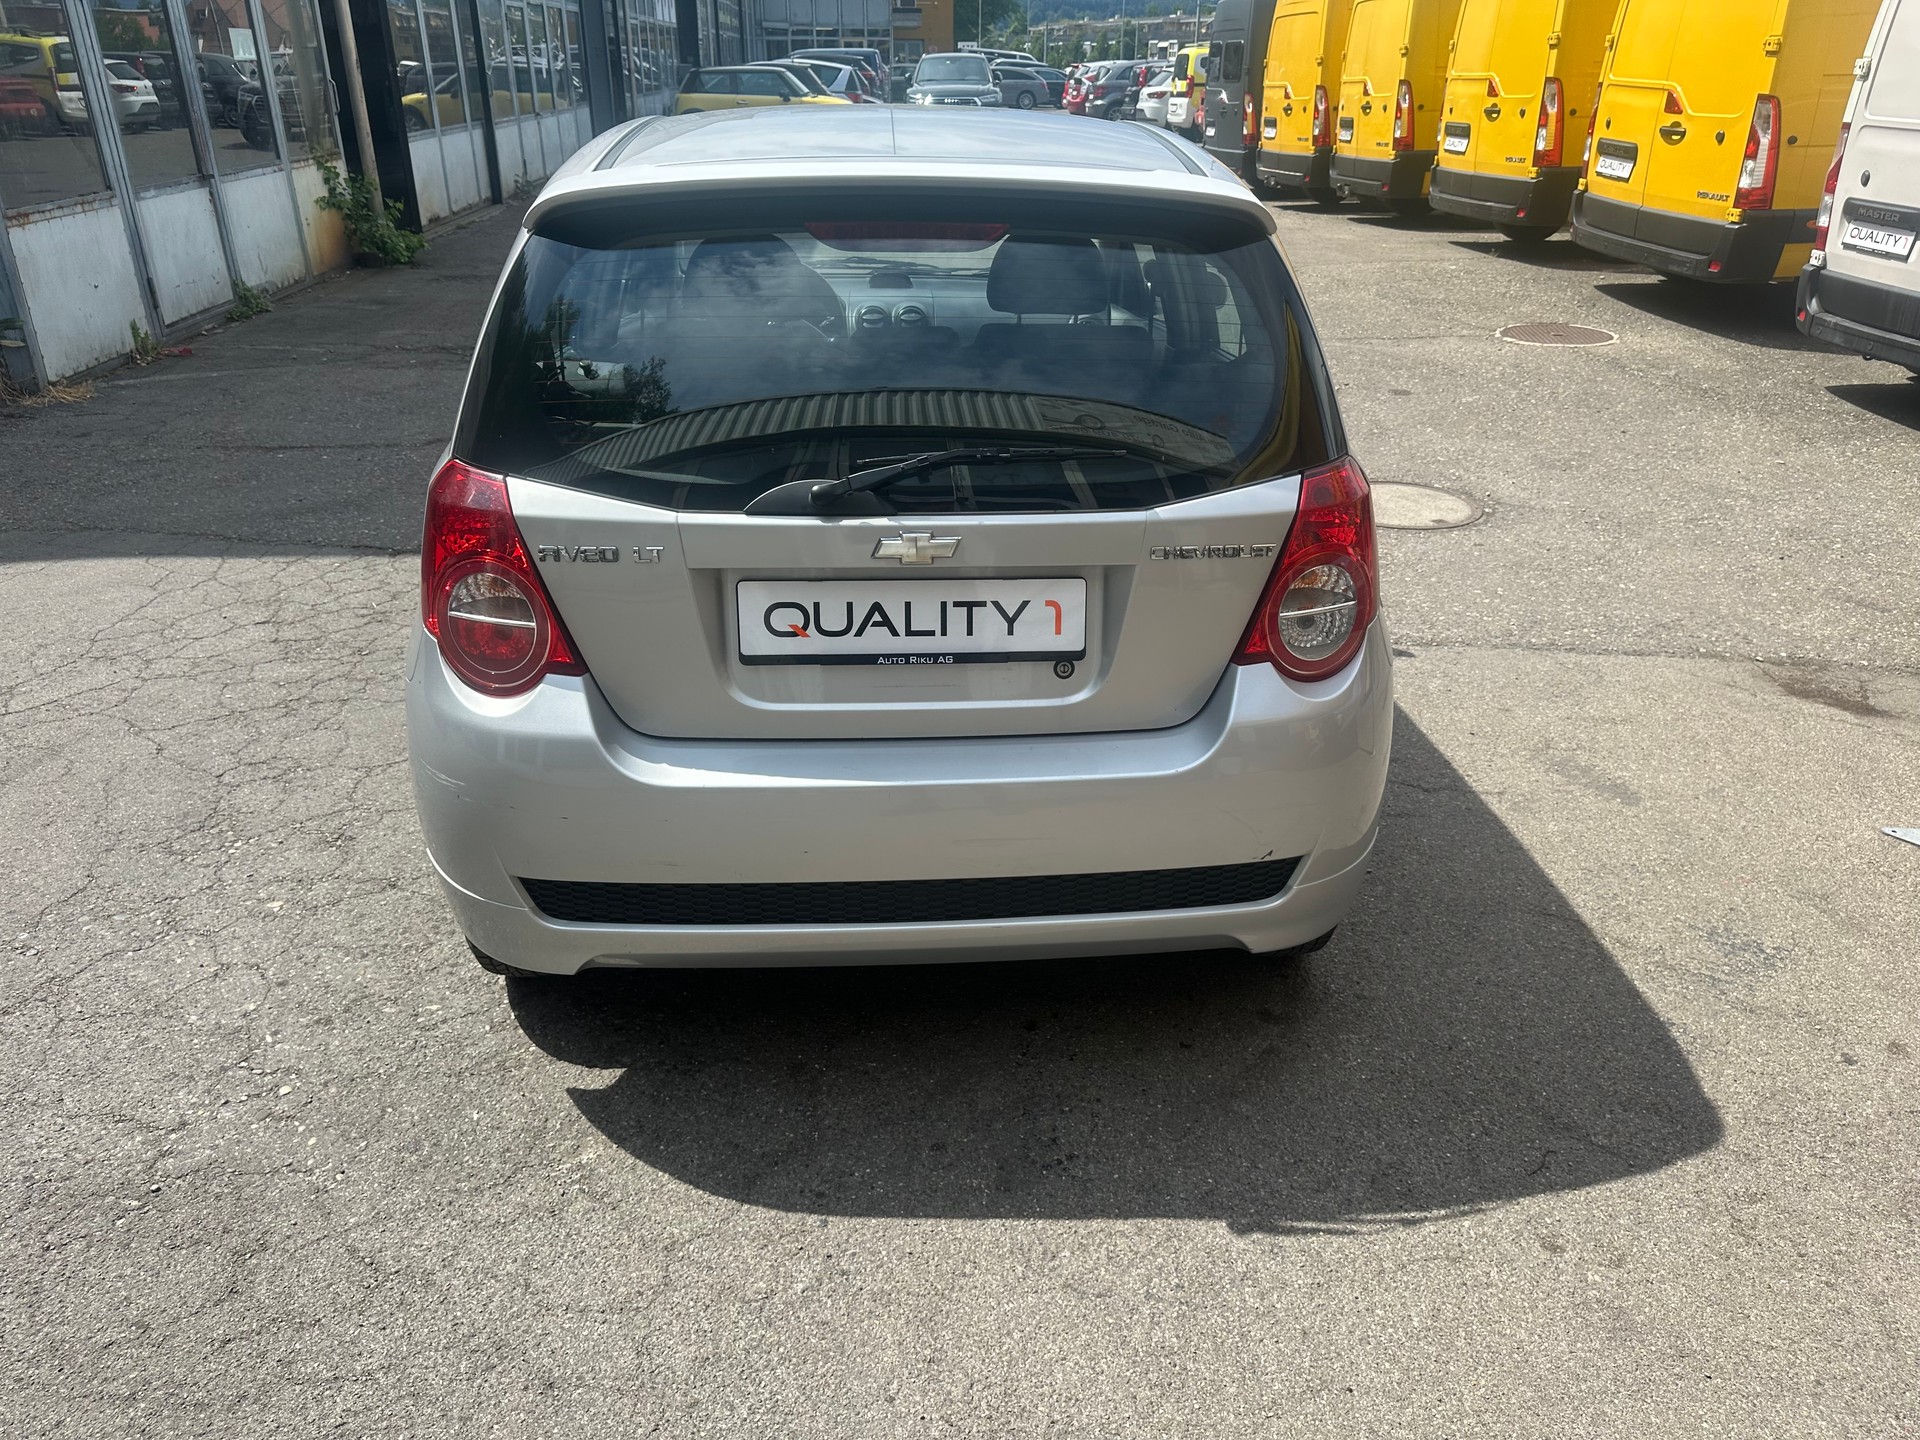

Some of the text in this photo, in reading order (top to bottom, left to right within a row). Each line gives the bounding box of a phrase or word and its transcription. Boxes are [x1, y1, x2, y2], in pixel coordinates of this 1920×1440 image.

[1857, 207, 1901, 222] MASTER
[1849, 227, 1909, 249] QUALITY 1
[537, 545, 664, 563] AVEO LT
[1150, 543, 1277, 561] CHEVROLET
[763, 599, 1063, 638] QUALITY 1
[937, 655, 954, 664] AG
